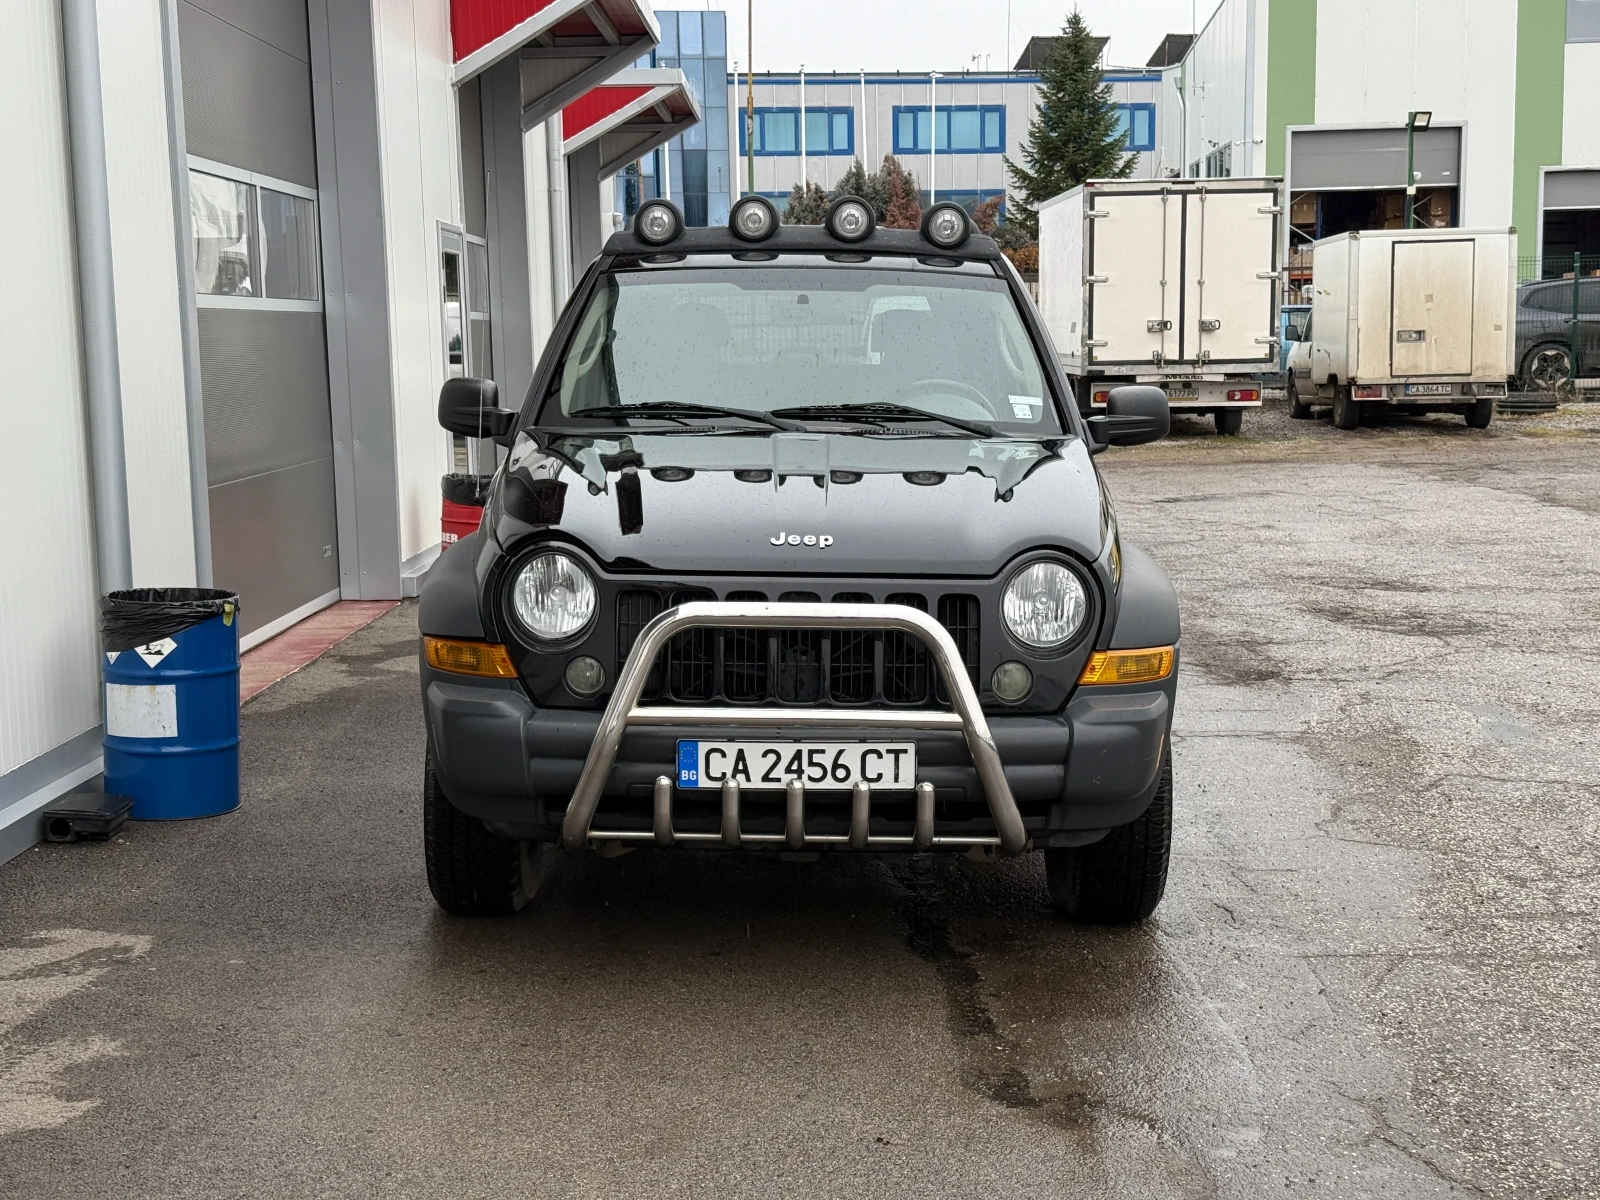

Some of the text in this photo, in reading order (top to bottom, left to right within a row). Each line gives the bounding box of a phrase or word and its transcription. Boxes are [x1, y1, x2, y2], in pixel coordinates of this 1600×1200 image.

[1169, 389, 1186, 397] 6177
[1420, 385, 1439, 393] 3864
[770, 531, 834, 549] Jeep
[704, 747, 908, 783] CA 2456 CT
[681, 770, 697, 781] BG
